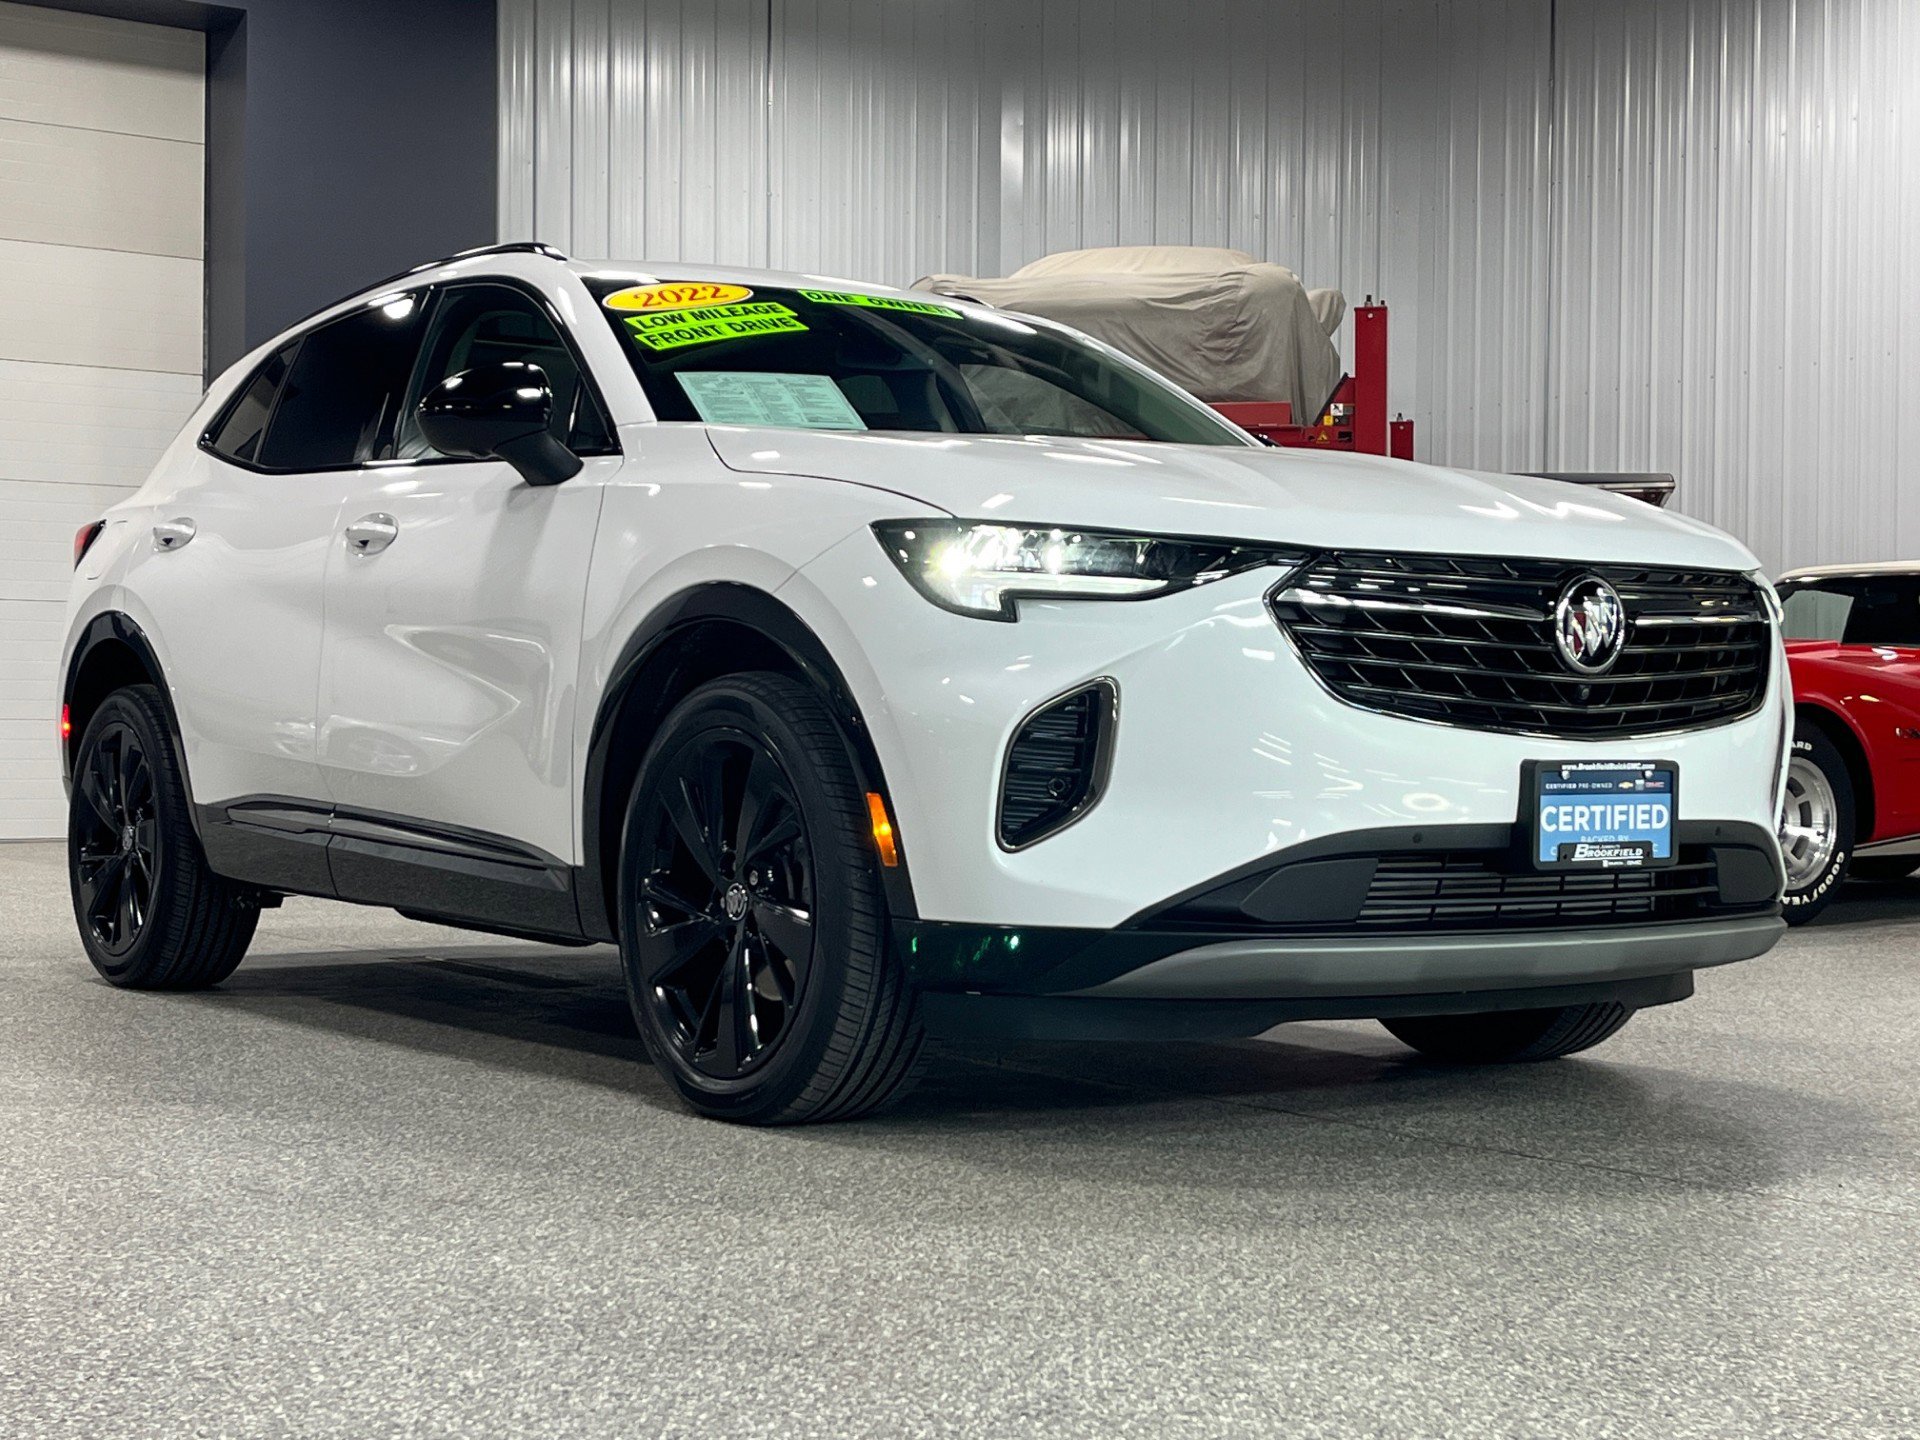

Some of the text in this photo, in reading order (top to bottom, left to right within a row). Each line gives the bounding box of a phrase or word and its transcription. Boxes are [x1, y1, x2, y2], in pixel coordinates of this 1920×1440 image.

[633, 285, 729, 308] 2022
[806, 290, 954, 317] ONE OWNER
[636, 302, 784, 329] LOW MILEAGE
[643, 317, 797, 347] FRONT DRIVE
[1540, 804, 1669, 832] CERTIFIED
[1574, 844, 1643, 858] BROOKFIELD
[1781, 851, 1845, 905] GOODYEA
